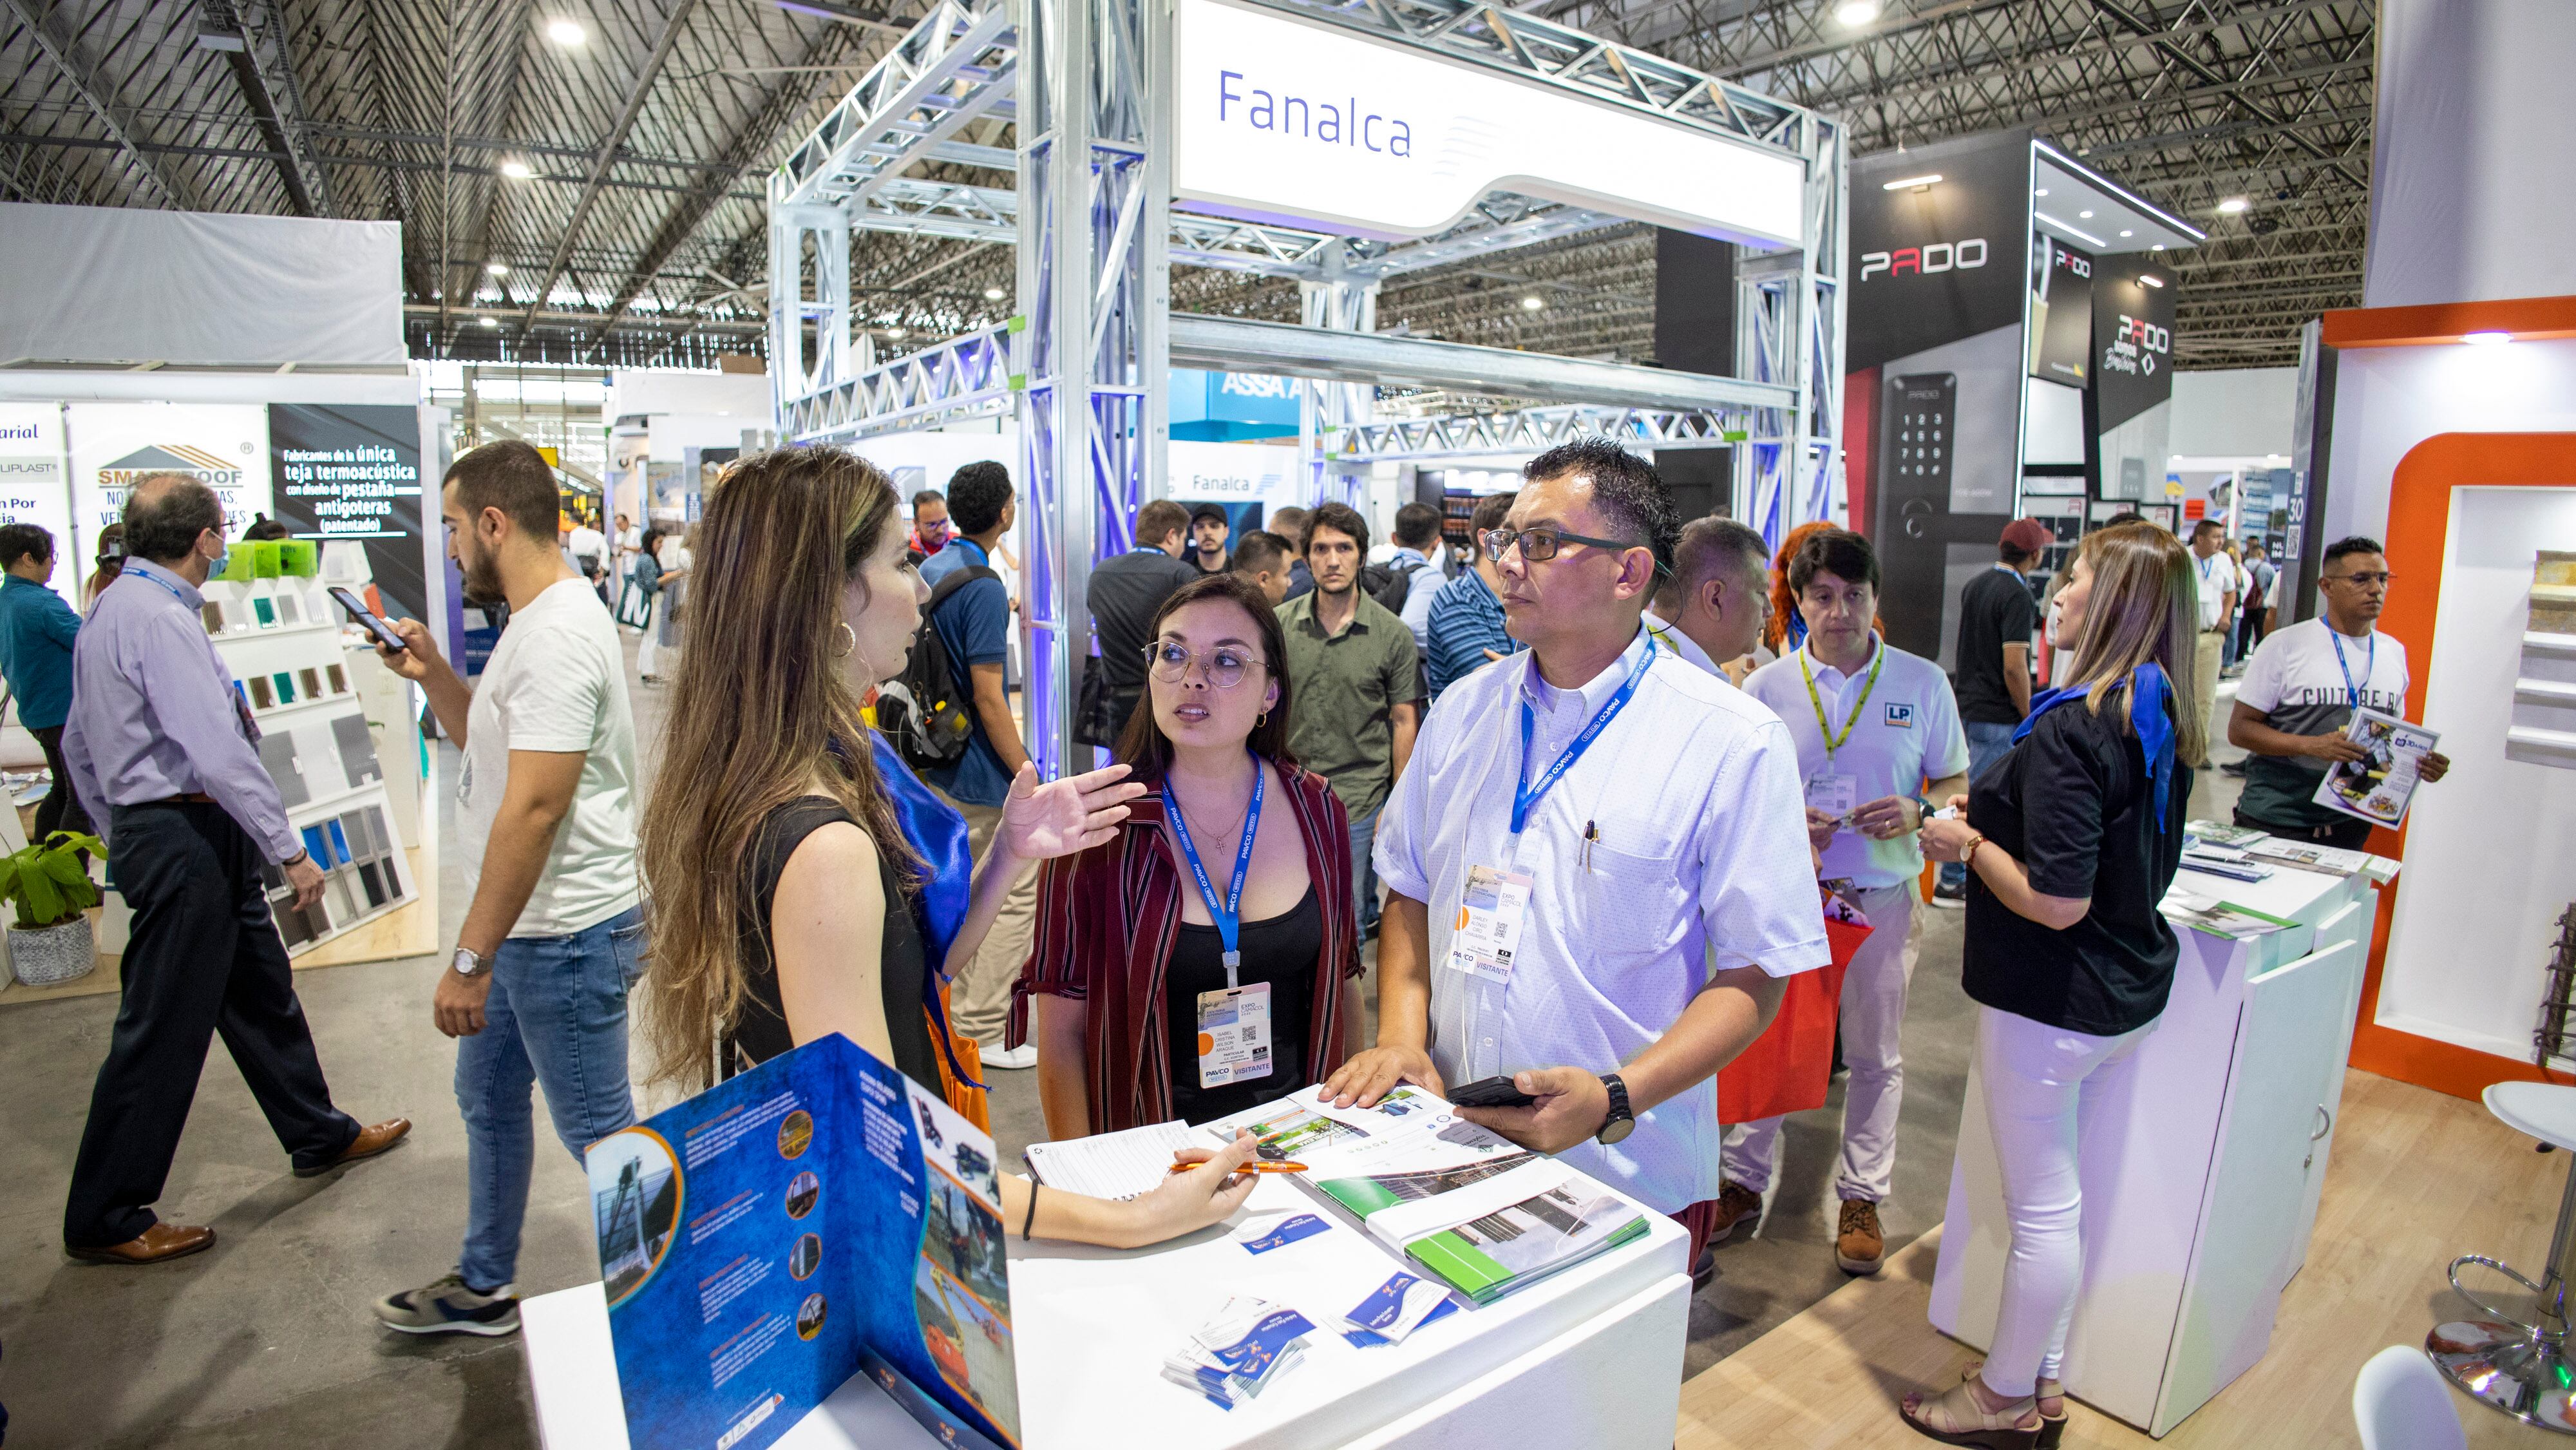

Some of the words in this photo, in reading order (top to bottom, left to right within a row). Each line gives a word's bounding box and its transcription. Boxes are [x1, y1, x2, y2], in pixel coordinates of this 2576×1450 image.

[1220, 70, 1410, 158] Fanalca
[1861, 238, 1988, 282] PADO
[2056, 249, 2090, 278] PADO
[2118, 314, 2169, 354] PADO
[1904, 414, 1910, 426] 1
[1918, 414, 1926, 425] 2
[1934, 413, 1942, 425] 3
[283, 449, 333, 462] Fabricantes
[334, 449, 345, 462] de
[346, 449, 355, 462] la
[357, 444, 397, 463] única
[1901, 448, 1909, 459] 7
[285, 463, 313, 484] teja
[316, 463, 417, 481] termoacústica
[1193, 475, 1249, 491] Fanalca
[286, 485, 303, 496] con
[303, 482, 330, 496] diseño
[330, 482, 342, 495] de
[342, 480, 395, 501] pestaña
[11, 499, 36, 508] Por
[315, 498, 392, 519] antigoteras
[2287, 497, 2304, 522] 30
[319, 517, 381, 533] (patentado)
[1639, 648, 1653, 671] PAVCO
[1599, 698, 1620, 722] PAVCO
[1889, 707, 1909, 719] LP
[1582, 722, 1600, 741] wavin
[1551, 750, 1574, 774] PAVCO
[1255, 777, 1264, 801] PAVCO
[1535, 774, 1553, 793] wavin
[1170, 807, 1183, 831] PAVCO
[1180, 832, 1191, 851] wavin
[1242, 835, 1252, 859] PAVCO
[1247, 814, 1256, 834] wavin
[1193, 863, 1208, 887] PAVCO
[1206, 888, 1217, 908] wavin
[1229, 893, 1237, 913] PAVCO
[1233, 872, 1242, 892] wavin
[1477, 961, 1509, 977] VISITANTE
[1206, 1067, 1229, 1077] PAVCO
[1234, 1063, 1270, 1075] VISITANTE
